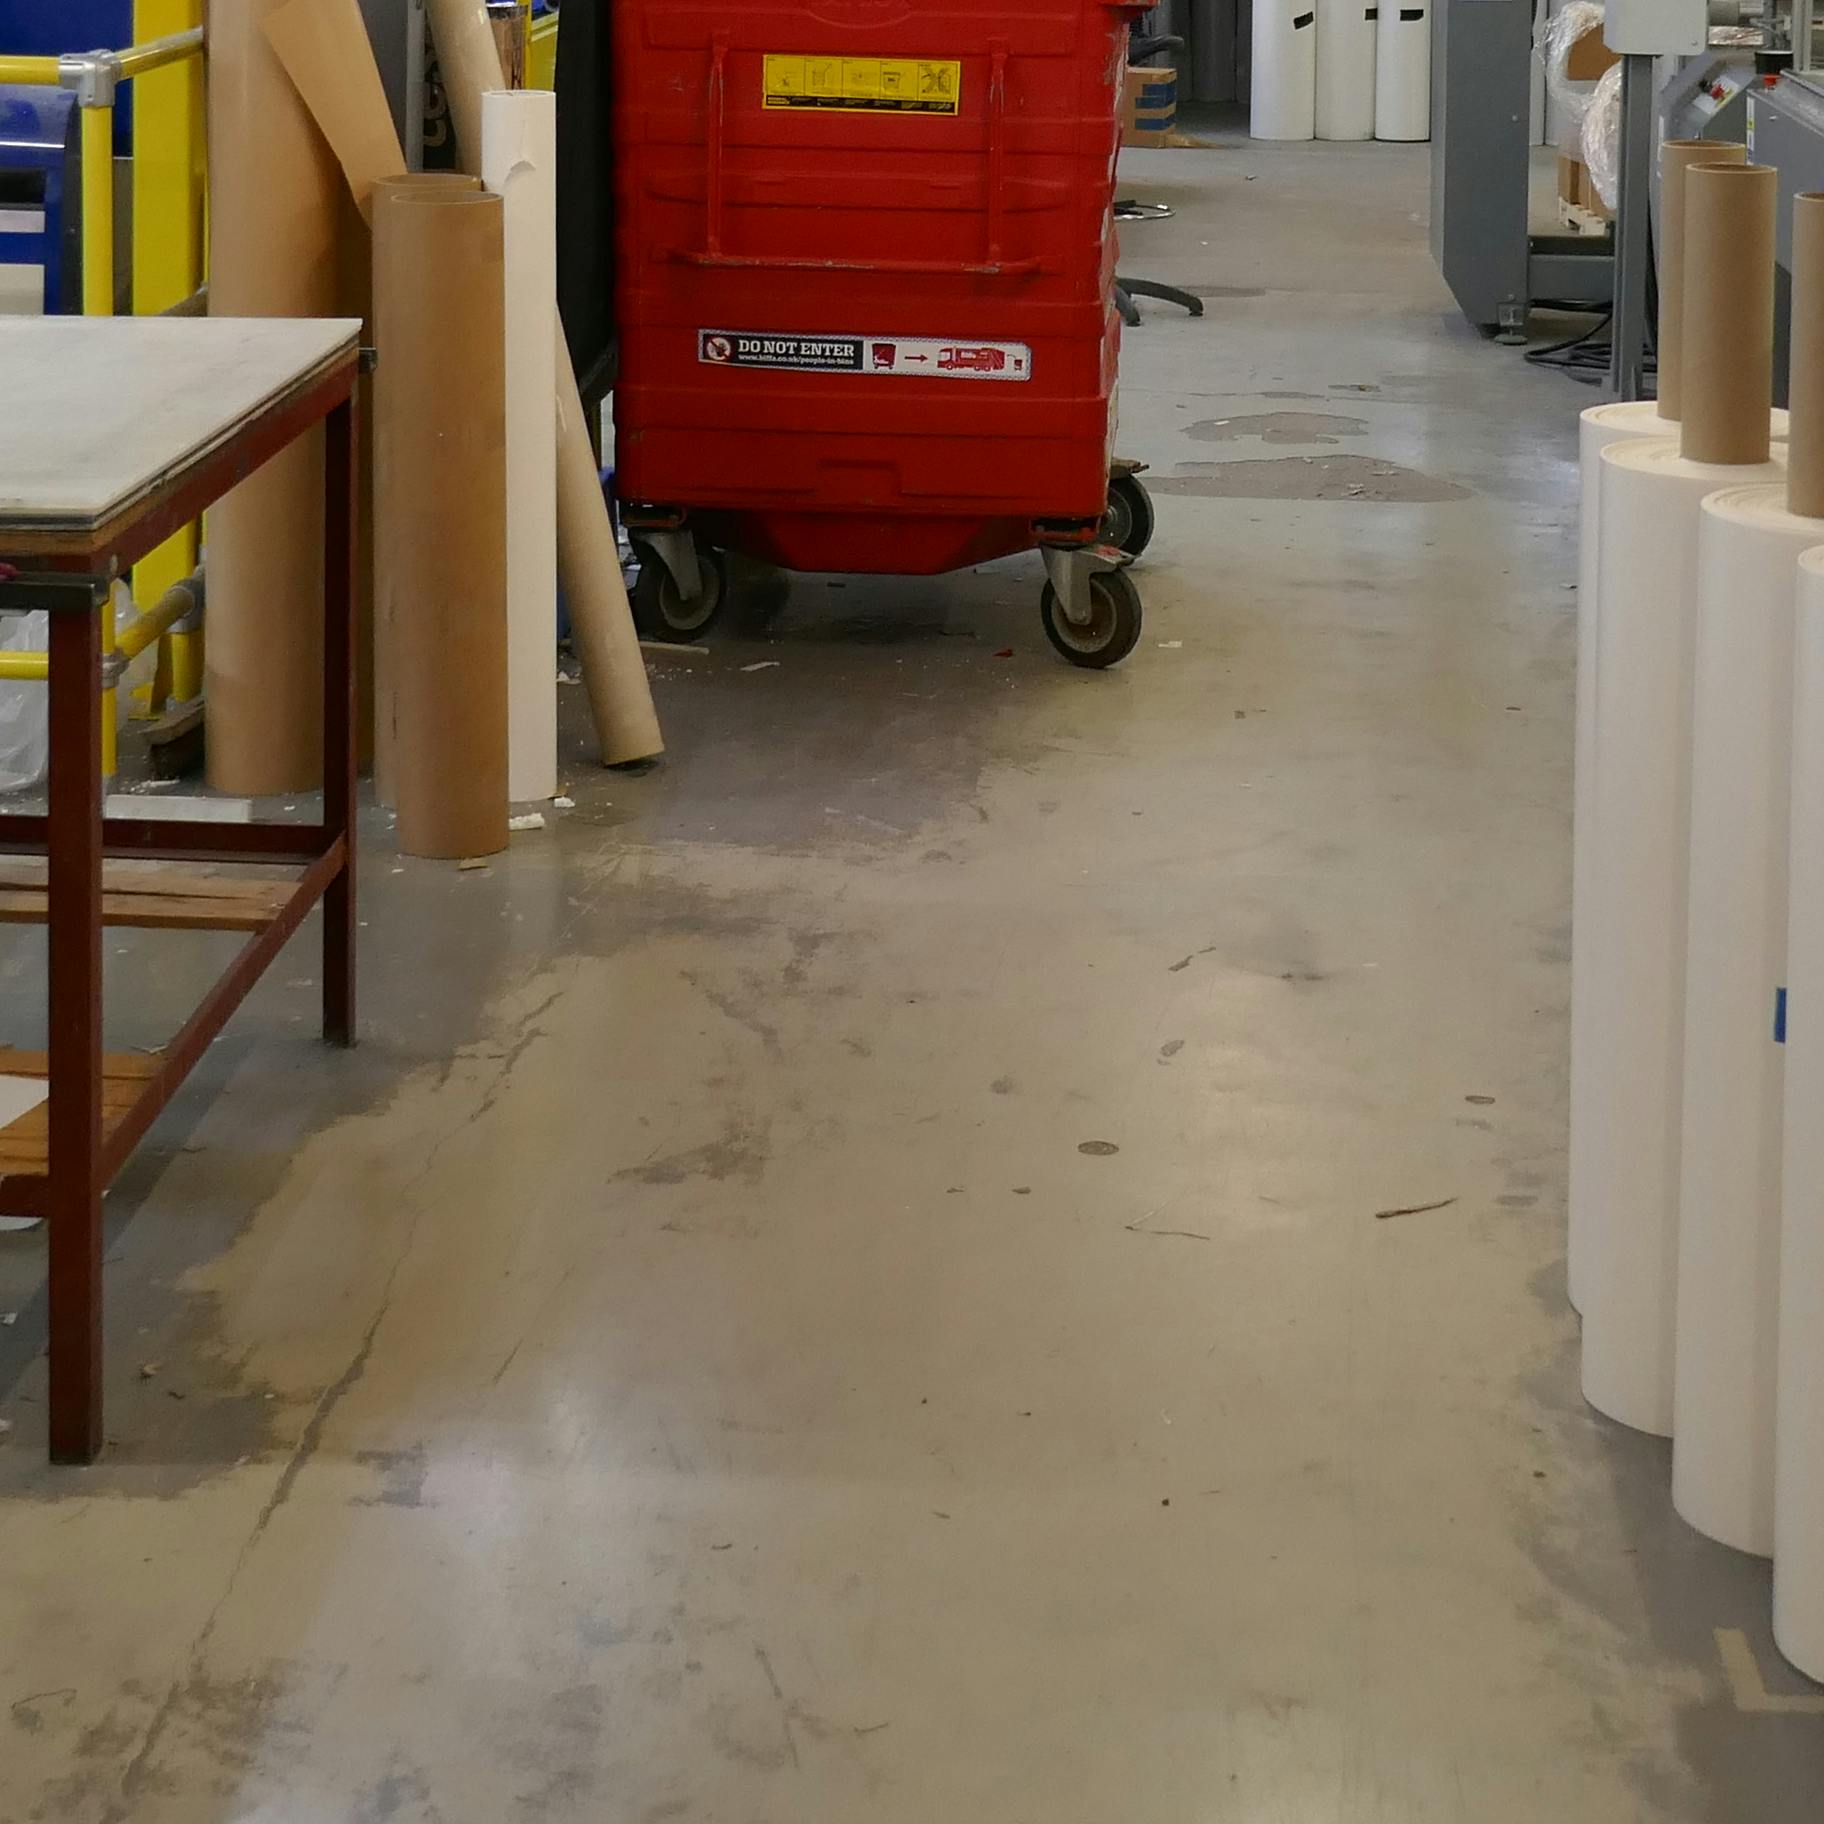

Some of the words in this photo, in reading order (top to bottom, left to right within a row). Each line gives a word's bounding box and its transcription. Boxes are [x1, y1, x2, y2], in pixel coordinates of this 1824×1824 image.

[738, 339, 761, 353] DO
[764, 341, 798, 355] NOT
[800, 343, 855, 358] ENTER
